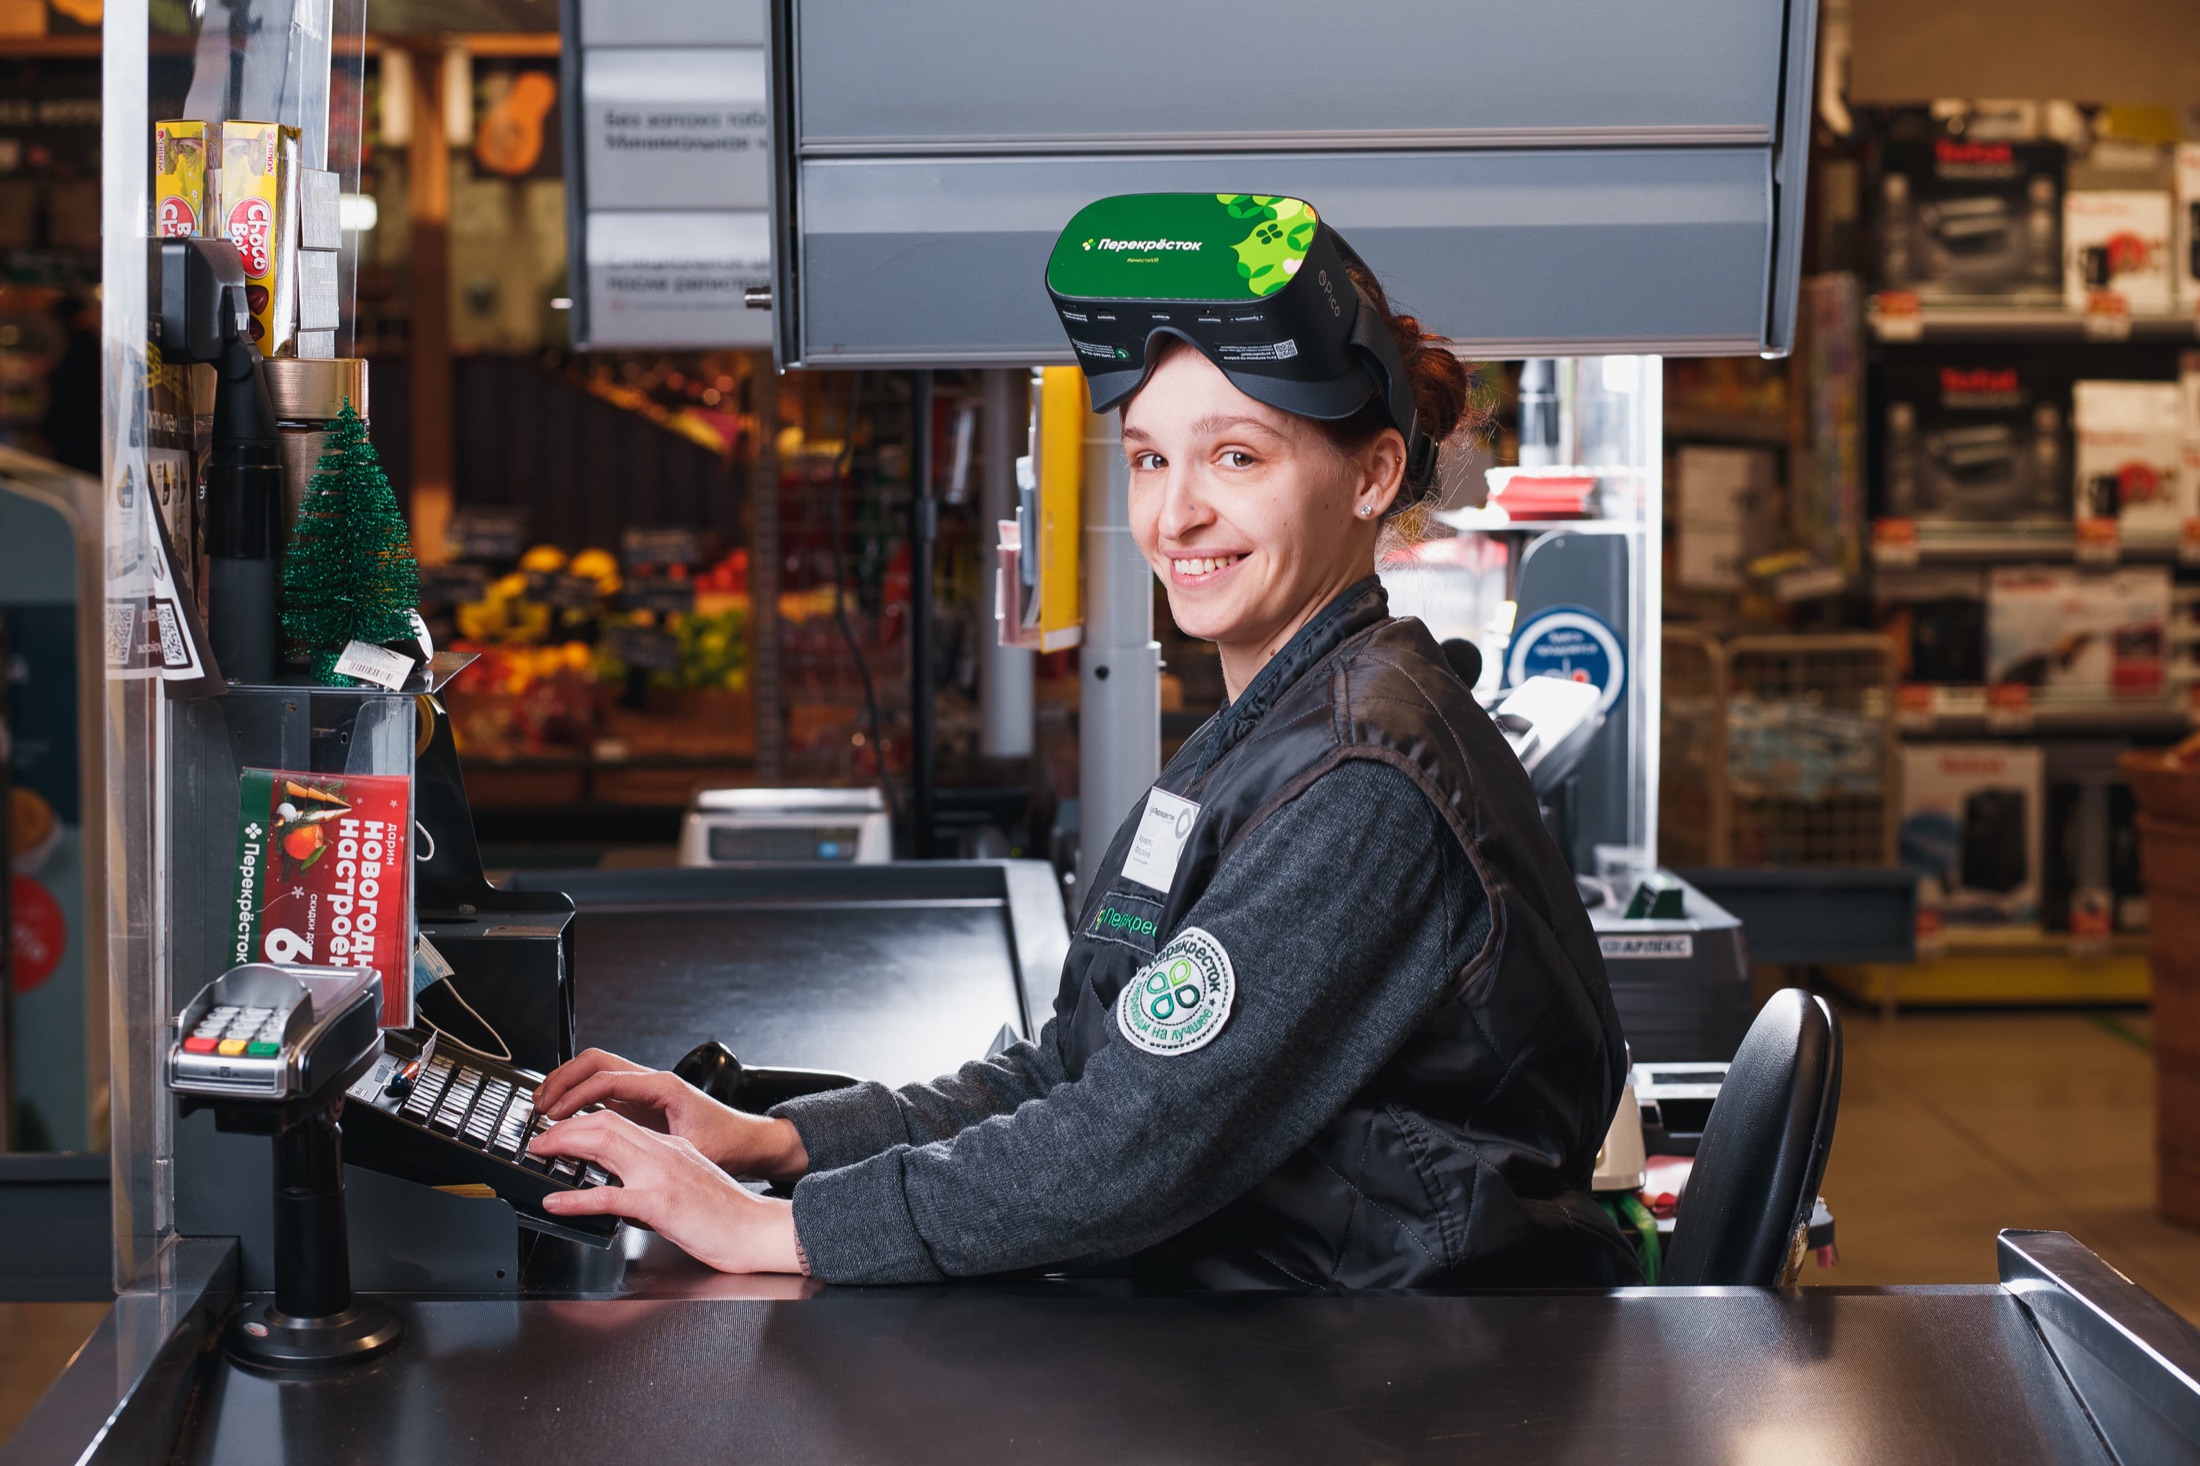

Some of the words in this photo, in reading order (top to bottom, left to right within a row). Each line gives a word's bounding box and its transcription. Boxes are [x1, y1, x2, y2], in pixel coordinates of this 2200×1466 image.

[247, 204, 268, 270] Choco
[1097, 238, 1203, 252] Перекрёсток
[386, 823, 397, 866] дарим
[236, 842, 261, 963] Перекрёсток
[307, 893, 318, 931] скидки
[264, 927, 314, 964] 6
[1152, 1027, 1168, 1040] на
